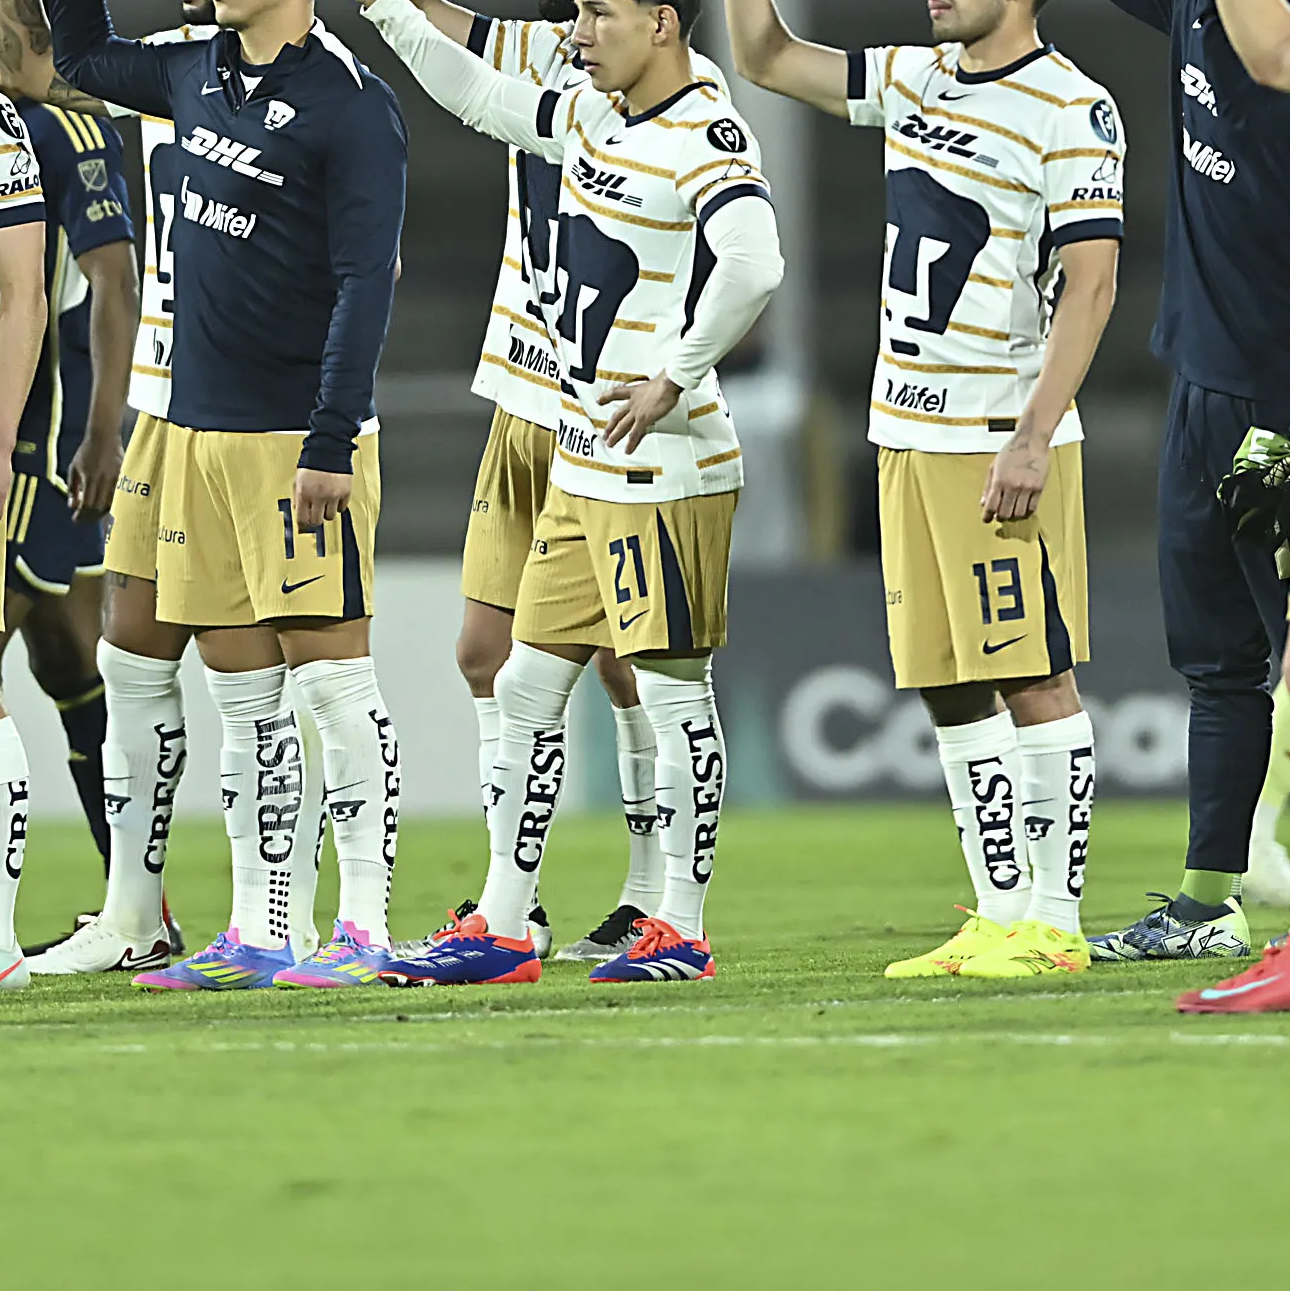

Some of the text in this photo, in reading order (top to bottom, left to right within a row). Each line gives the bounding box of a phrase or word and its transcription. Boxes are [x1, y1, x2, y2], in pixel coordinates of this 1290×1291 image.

[190, 126, 264, 177] DHL
[899, 114, 980, 160] DHL
[1190, 140, 1236, 184] Mifel
[574, 156, 628, 201] DHL
[204, 199, 257, 239] Mifel
[894, 381, 948, 413] Mifel
[609, 534, 648, 604] 21
[972, 556, 1026, 625] 13
[143, 721, 189, 874] CREST
[255, 710, 301, 864] CREST
[513, 724, 565, 873] CREST
[681, 718, 724, 885] CREST
[967, 754, 1022, 891] CREST
